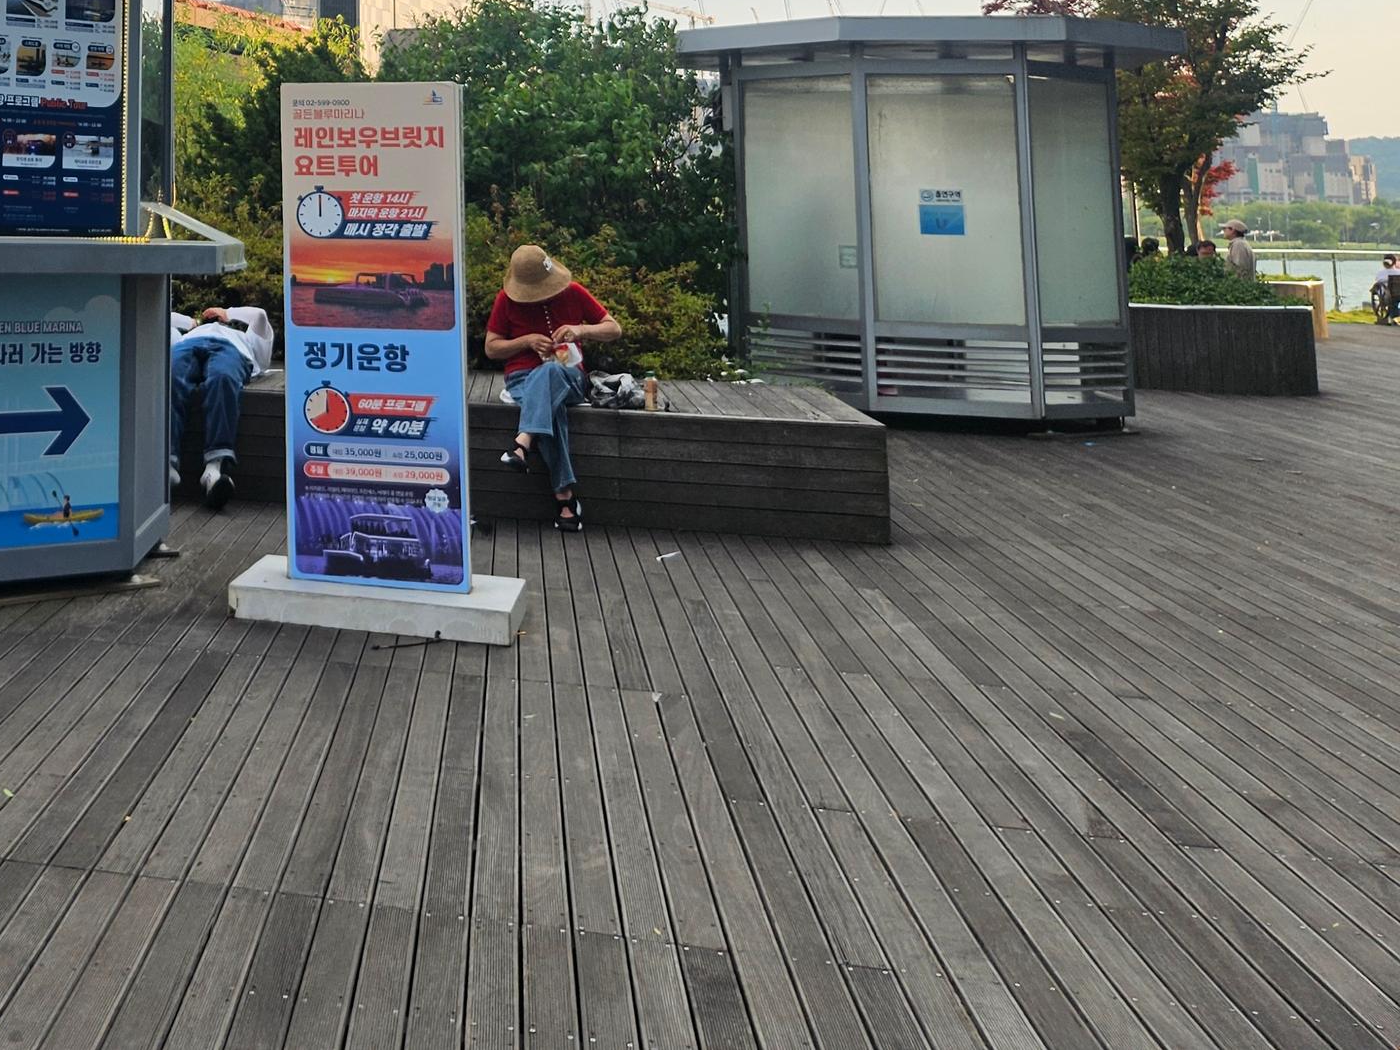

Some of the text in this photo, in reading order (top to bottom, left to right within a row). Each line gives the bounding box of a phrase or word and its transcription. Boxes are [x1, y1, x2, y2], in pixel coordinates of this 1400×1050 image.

[5, 94, 39, 108] 프로그램
[40, 97, 68, 110] Public
[69, 99, 88, 110] Tour
[294, 126, 444, 148] 레인보우브릿지
[294, 155, 379, 177] 요트투어
[362, 192, 384, 204] 운항
[386, 192, 410, 204] 14시
[347, 206, 425, 219] 마지막 운항 21시
[343, 222, 428, 238] 매시 정각 출발
[14, 321, 40, 334] BLUE
[43, 320, 84, 334] MARINA
[30, 341, 63, 364] 가는
[69, 341, 102, 363] 방향
[304, 342, 410, 373] 정기운항
[357, 398, 427, 413] 60분 프로그램
[371, 418, 425, 436] 약 40분
[344, 447, 382, 458] 35,000원
[404, 451, 443, 461] 25,000원
[404, 470, 443, 481] 29,000원
